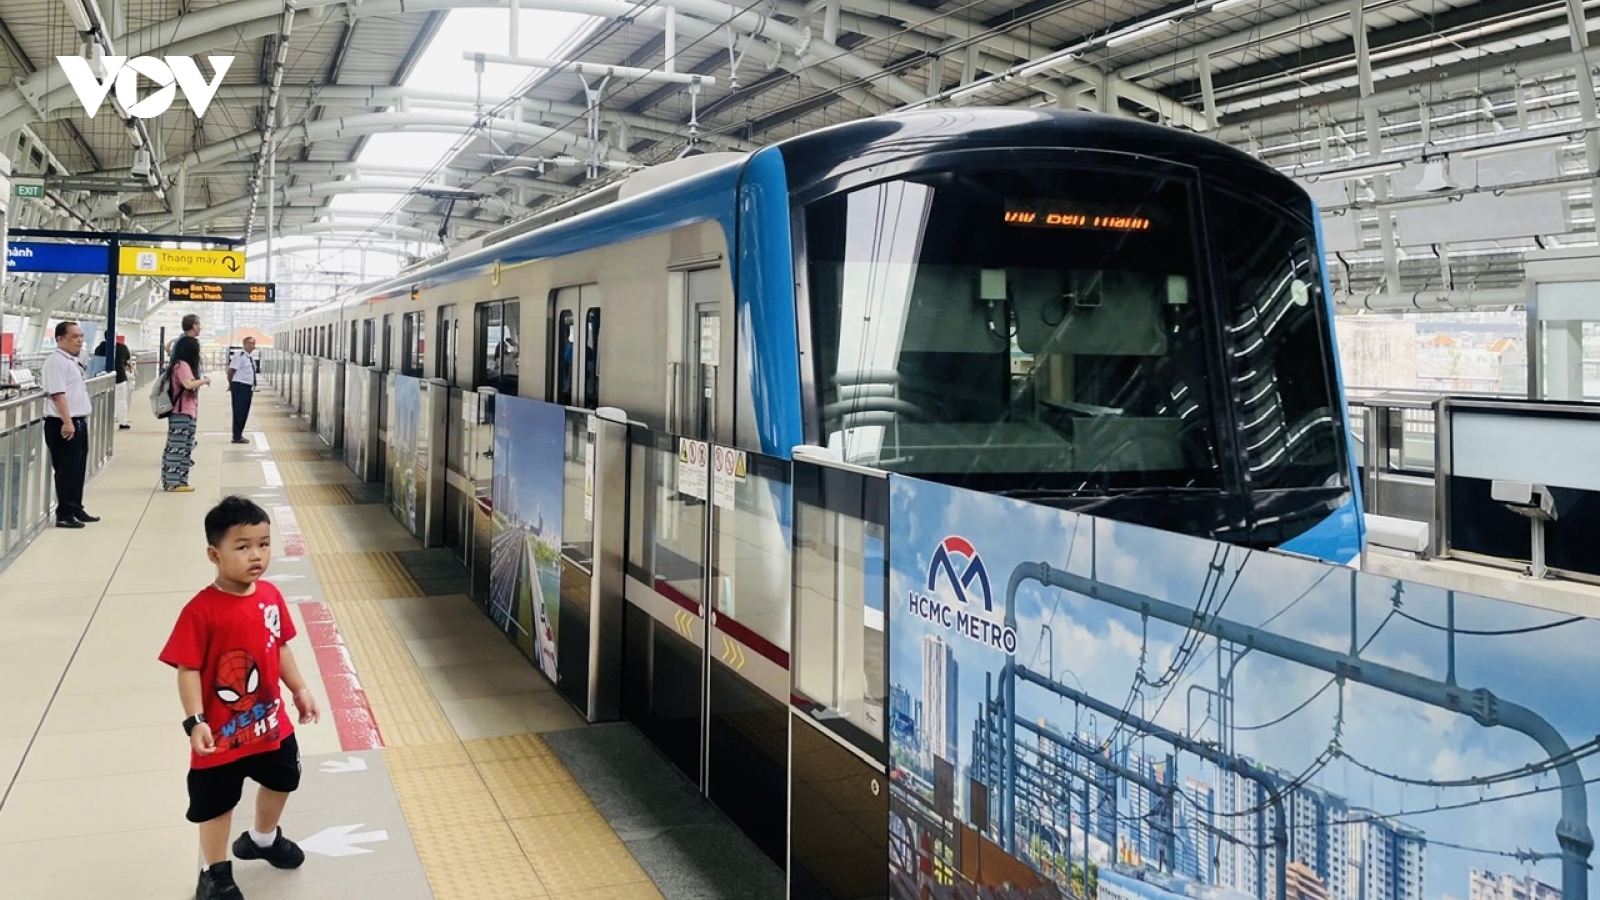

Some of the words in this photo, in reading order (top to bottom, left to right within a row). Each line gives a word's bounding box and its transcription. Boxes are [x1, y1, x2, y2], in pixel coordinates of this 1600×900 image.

[18, 185, 39, 196] EXIT
[161, 252, 193, 264] Thang
[909, 591, 952, 629] HCMC
[955, 609, 1018, 654] METRO
